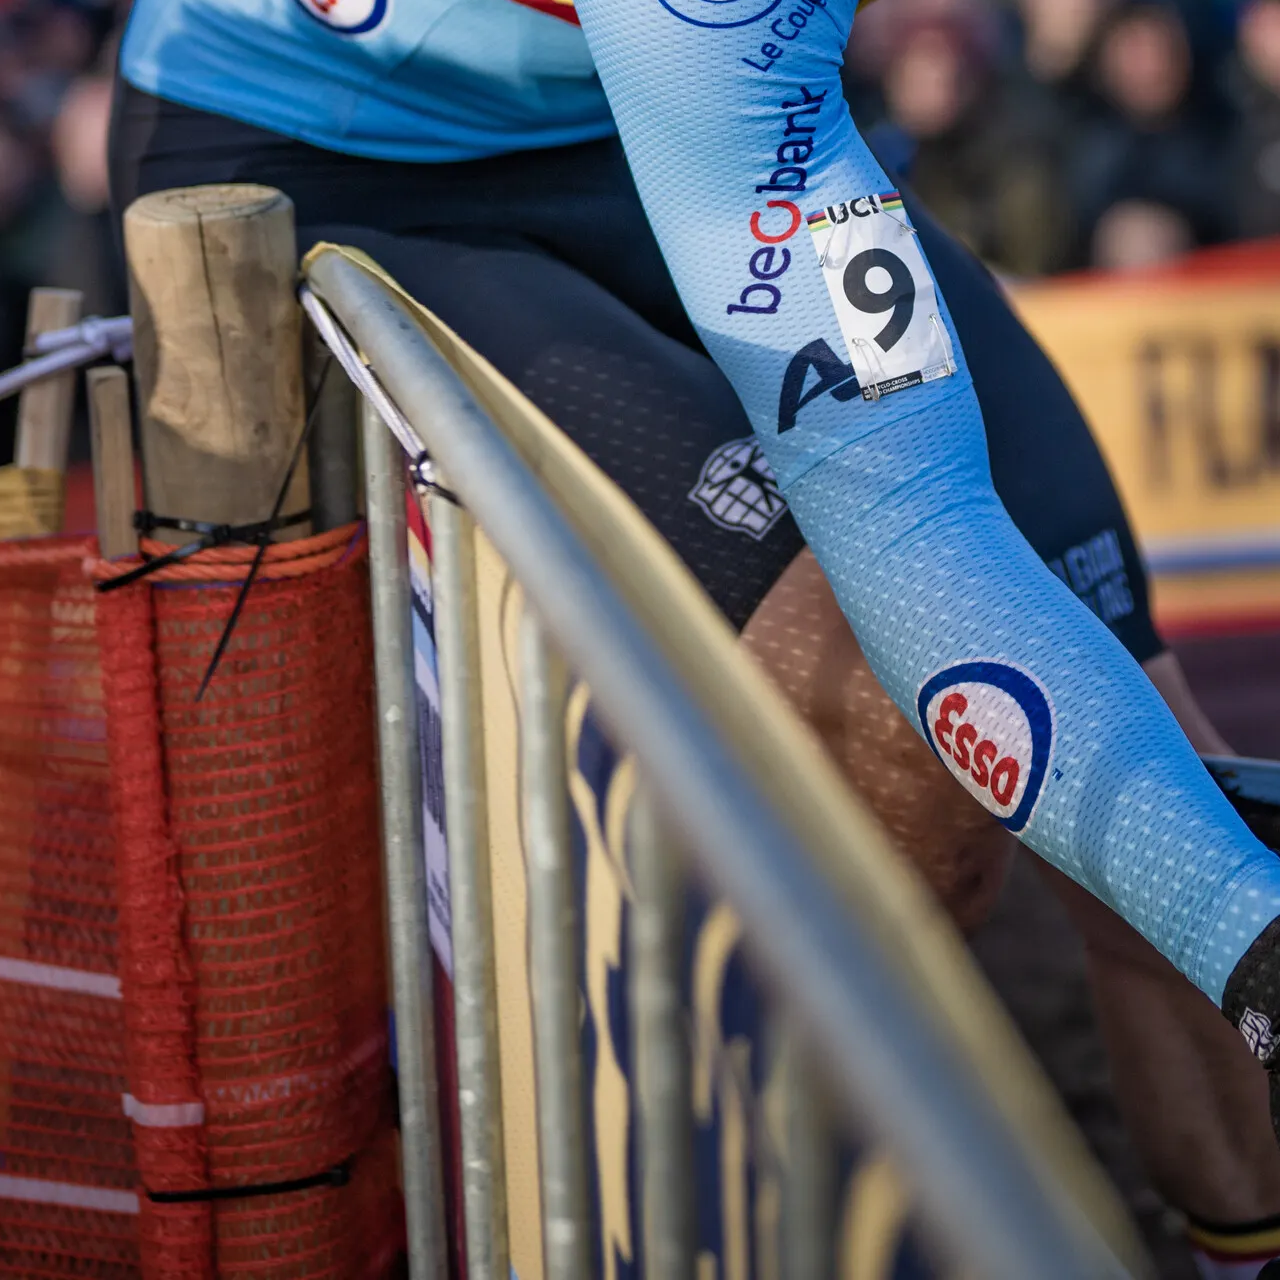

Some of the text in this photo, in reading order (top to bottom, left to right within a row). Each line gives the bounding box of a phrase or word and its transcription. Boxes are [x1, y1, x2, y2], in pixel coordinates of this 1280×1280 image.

[741, 42, 784, 73] Le
[826, 194, 880, 224] UCI
[842, 248, 916, 353] 9
